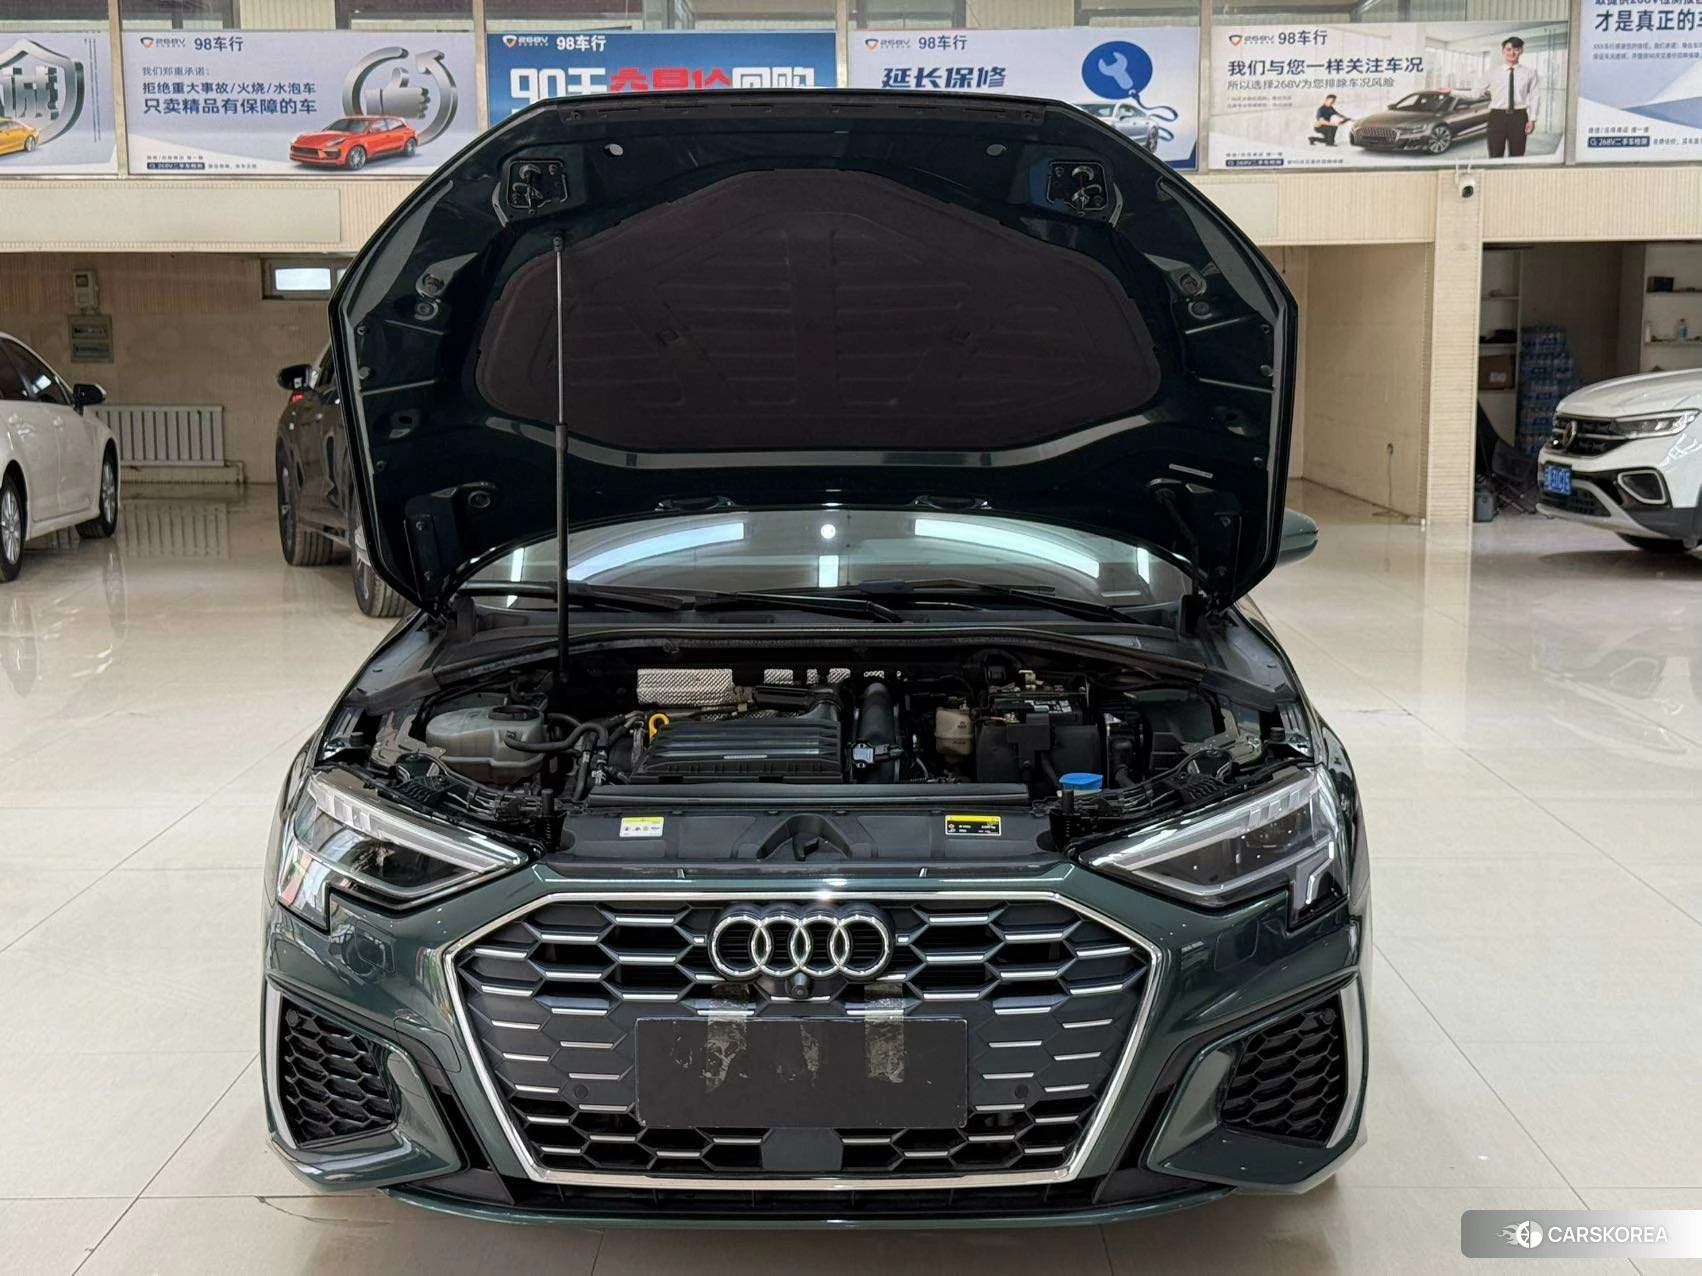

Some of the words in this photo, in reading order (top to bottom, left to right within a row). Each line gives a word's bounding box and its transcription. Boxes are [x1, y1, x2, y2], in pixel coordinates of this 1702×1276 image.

[1595, 8, 1702, 31] 才是真正的
[194, 36, 244, 51] 98车行
[556, 35, 606, 51] 98车行
[918, 35, 967, 50] 98车行
[1278, 29, 1327, 45] 98车行
[1227, 56, 1424, 76] 我们与您一样关注车况
[881, 66, 1006, 88] 延长保修
[143, 82, 316, 95] 拒绝重大事故/火烧/水泡车
[143, 98, 317, 114] 只卖精品有保障的车
